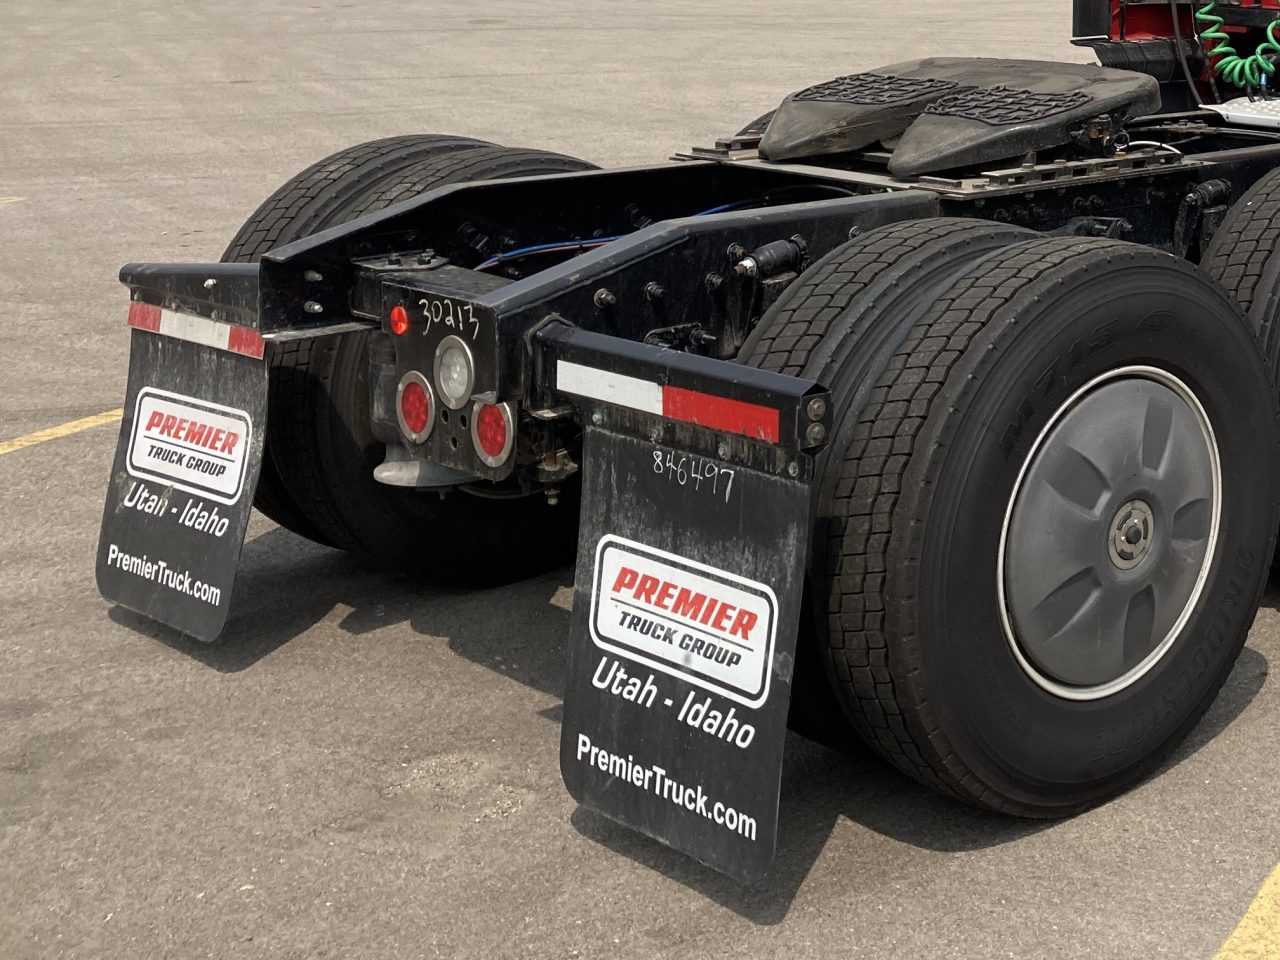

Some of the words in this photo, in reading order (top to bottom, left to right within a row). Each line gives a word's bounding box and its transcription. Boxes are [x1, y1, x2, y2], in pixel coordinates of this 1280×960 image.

[418, 298, 480, 340] 30213
[145, 410, 240, 455] PREMIER
[148, 444, 184, 467] TRUCK
[186, 455, 227, 477] GROUP
[652, 450, 735, 504] 846497
[123, 481, 170, 517] Utah
[179, 498, 230, 537] Idaho
[107, 544, 221, 606] PremierTruck.com
[611, 566, 758, 641] PREMIER
[618, 611, 676, 645] TRUCK
[678, 632, 742, 668] GROUP
[591, 656, 658, 708] Utah
[663, 697, 674, 707] -
[677, 690, 756, 749] Idaho
[576, 733, 757, 841] PremierTruck.com
